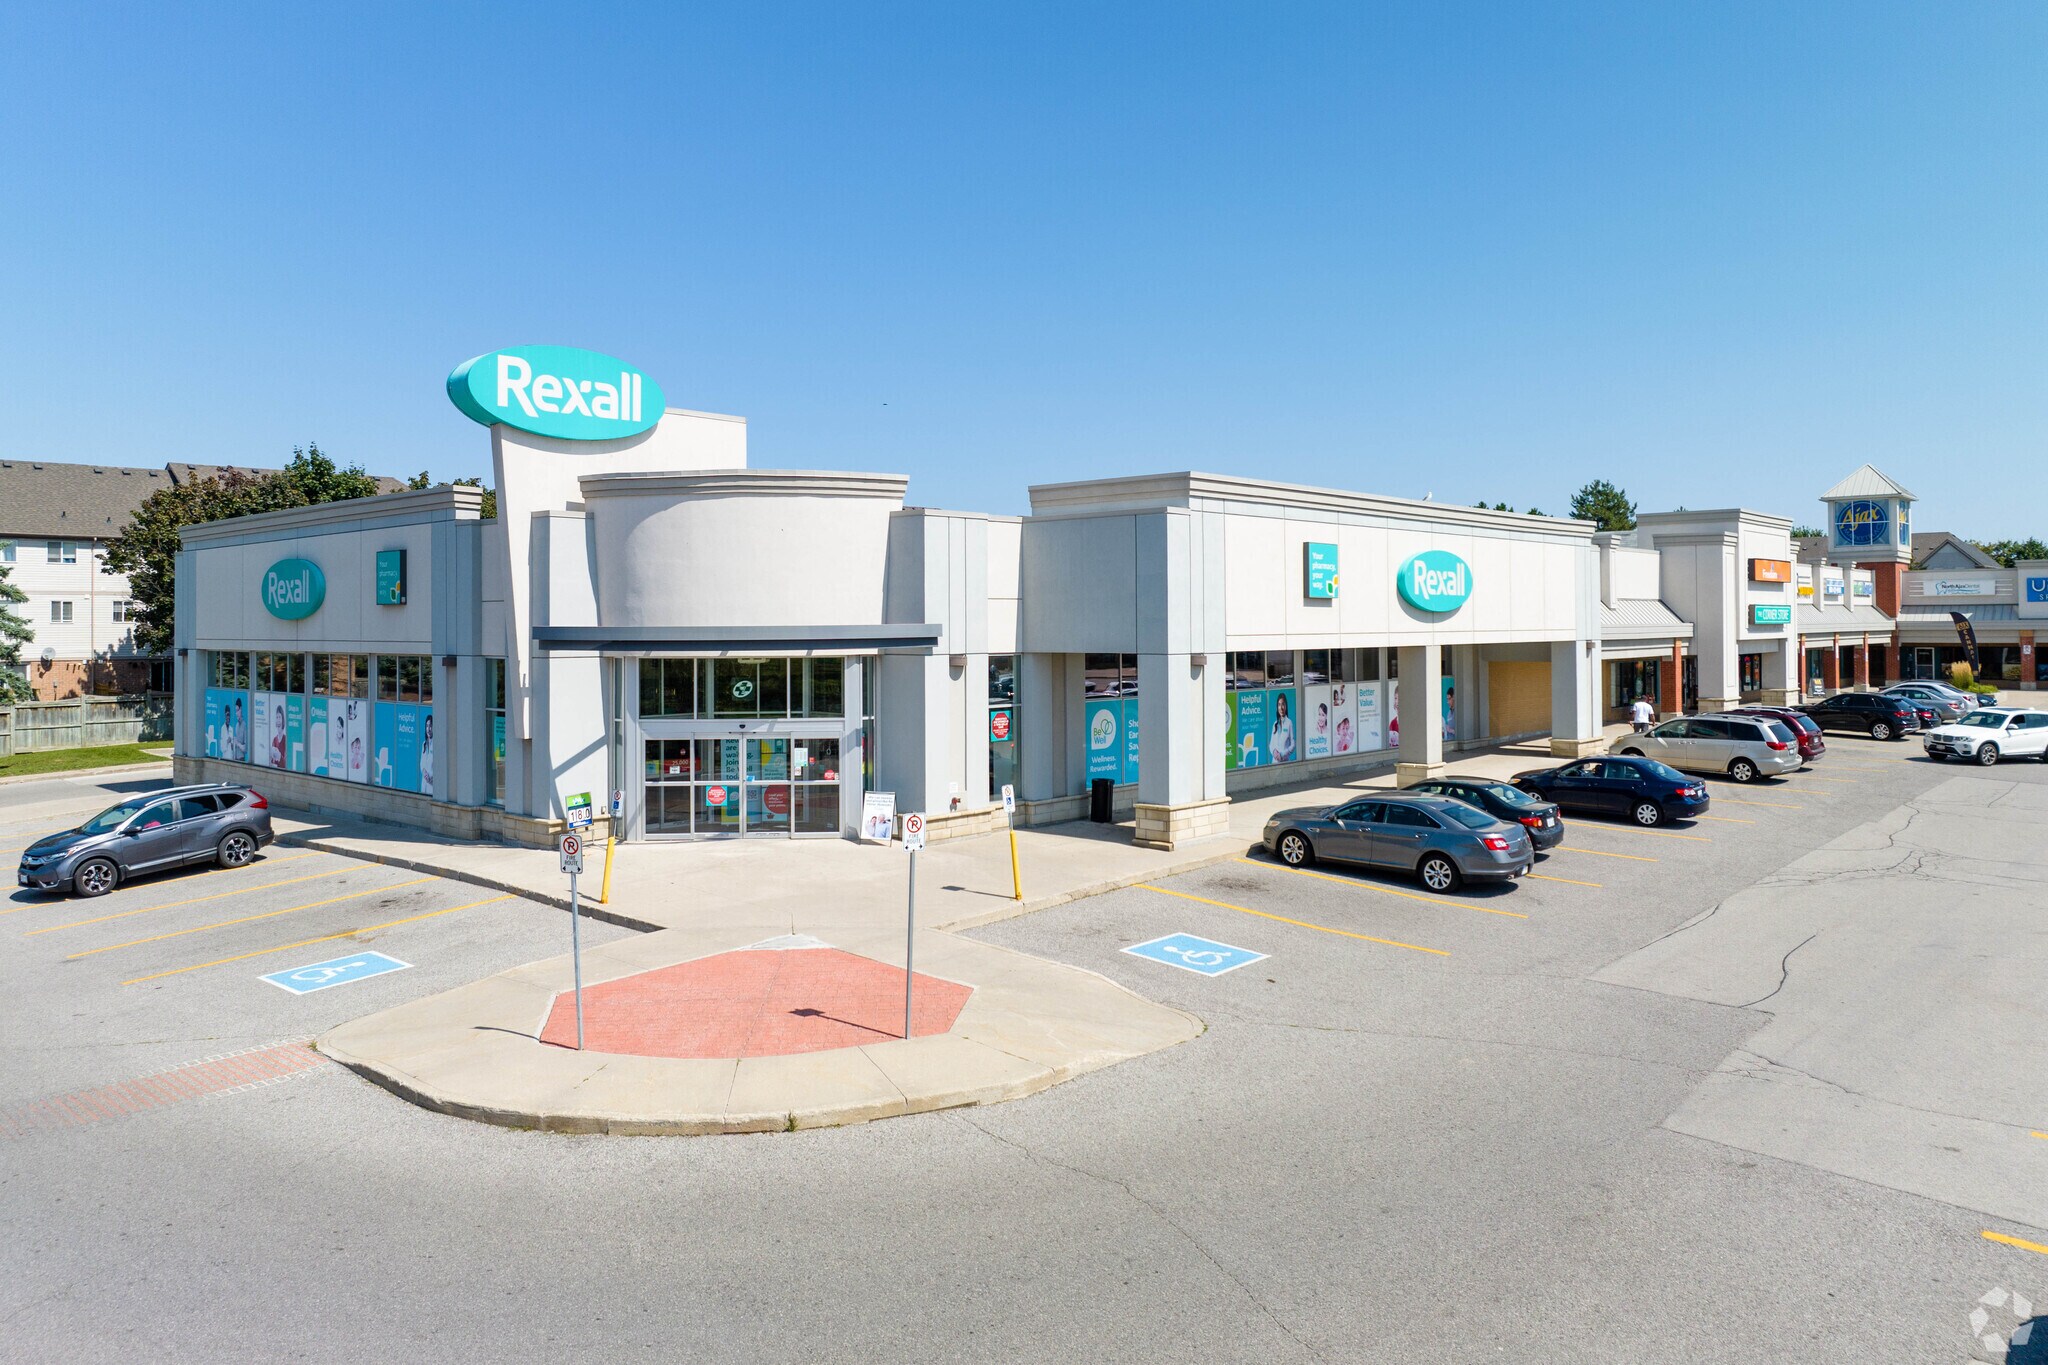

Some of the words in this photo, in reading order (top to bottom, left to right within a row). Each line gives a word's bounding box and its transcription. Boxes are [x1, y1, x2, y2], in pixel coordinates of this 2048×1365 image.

[497, 354, 642, 422] Rexall
[1840, 507, 1880, 531] Ajax
[1413, 559, 1465, 600] Rexall
[268, 569, 309, 608] Rexall
[1778, 609, 1789, 620] STORE
[1359, 688, 1375, 697] Better
[1241, 694, 1261, 705] Helpful
[1241, 706, 1262, 715] Advice.
[398, 713, 416, 723] Helpful
[1094, 728, 1102, 736] Be
[1094, 736, 1106, 744] Well
[1309, 736, 1327, 746] Healthy
[1091, 755, 1117, 763] Wellness.
[1090, 764, 1117, 773] Rewarded.
